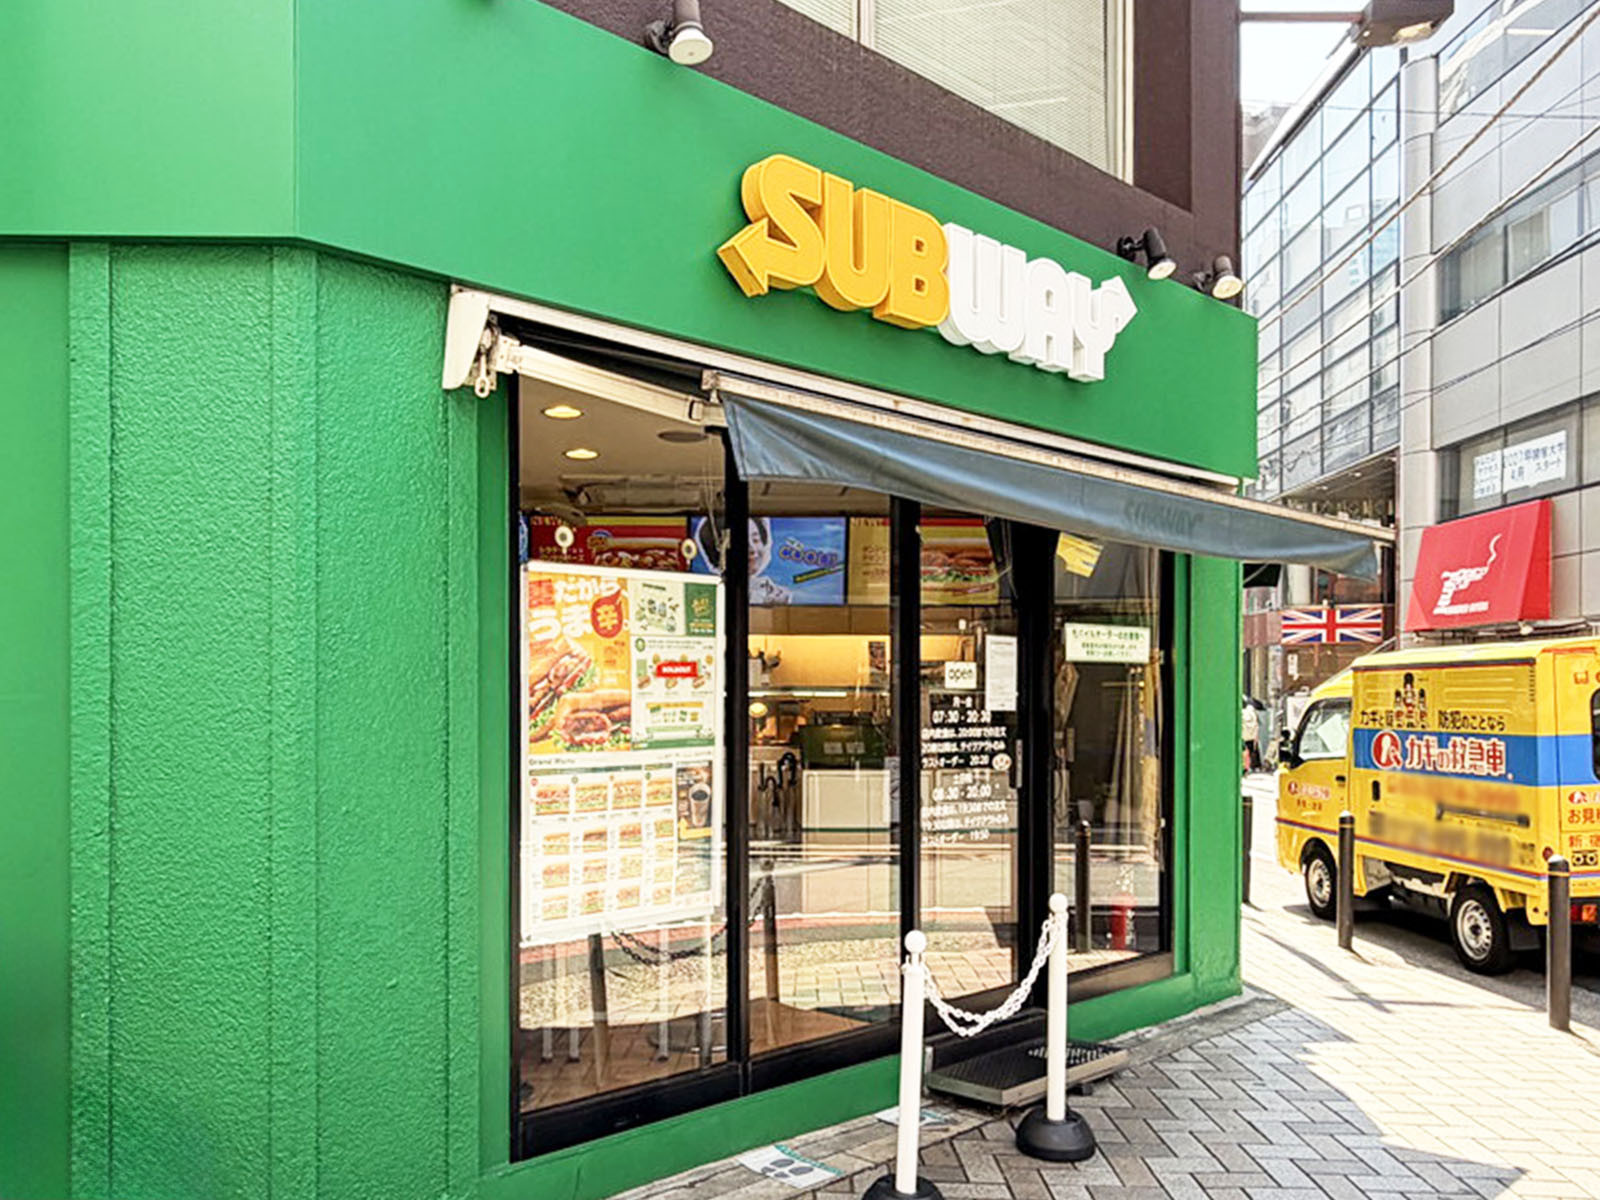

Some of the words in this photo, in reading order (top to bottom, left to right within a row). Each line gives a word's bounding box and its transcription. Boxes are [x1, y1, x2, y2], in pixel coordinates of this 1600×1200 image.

[717, 154, 1138, 383] SUBWAY
[948, 668, 974, 683] open
[1438, 710, 1506, 732] 防犯のことなら
[1405, 734, 1506, 777] カギの救急車
